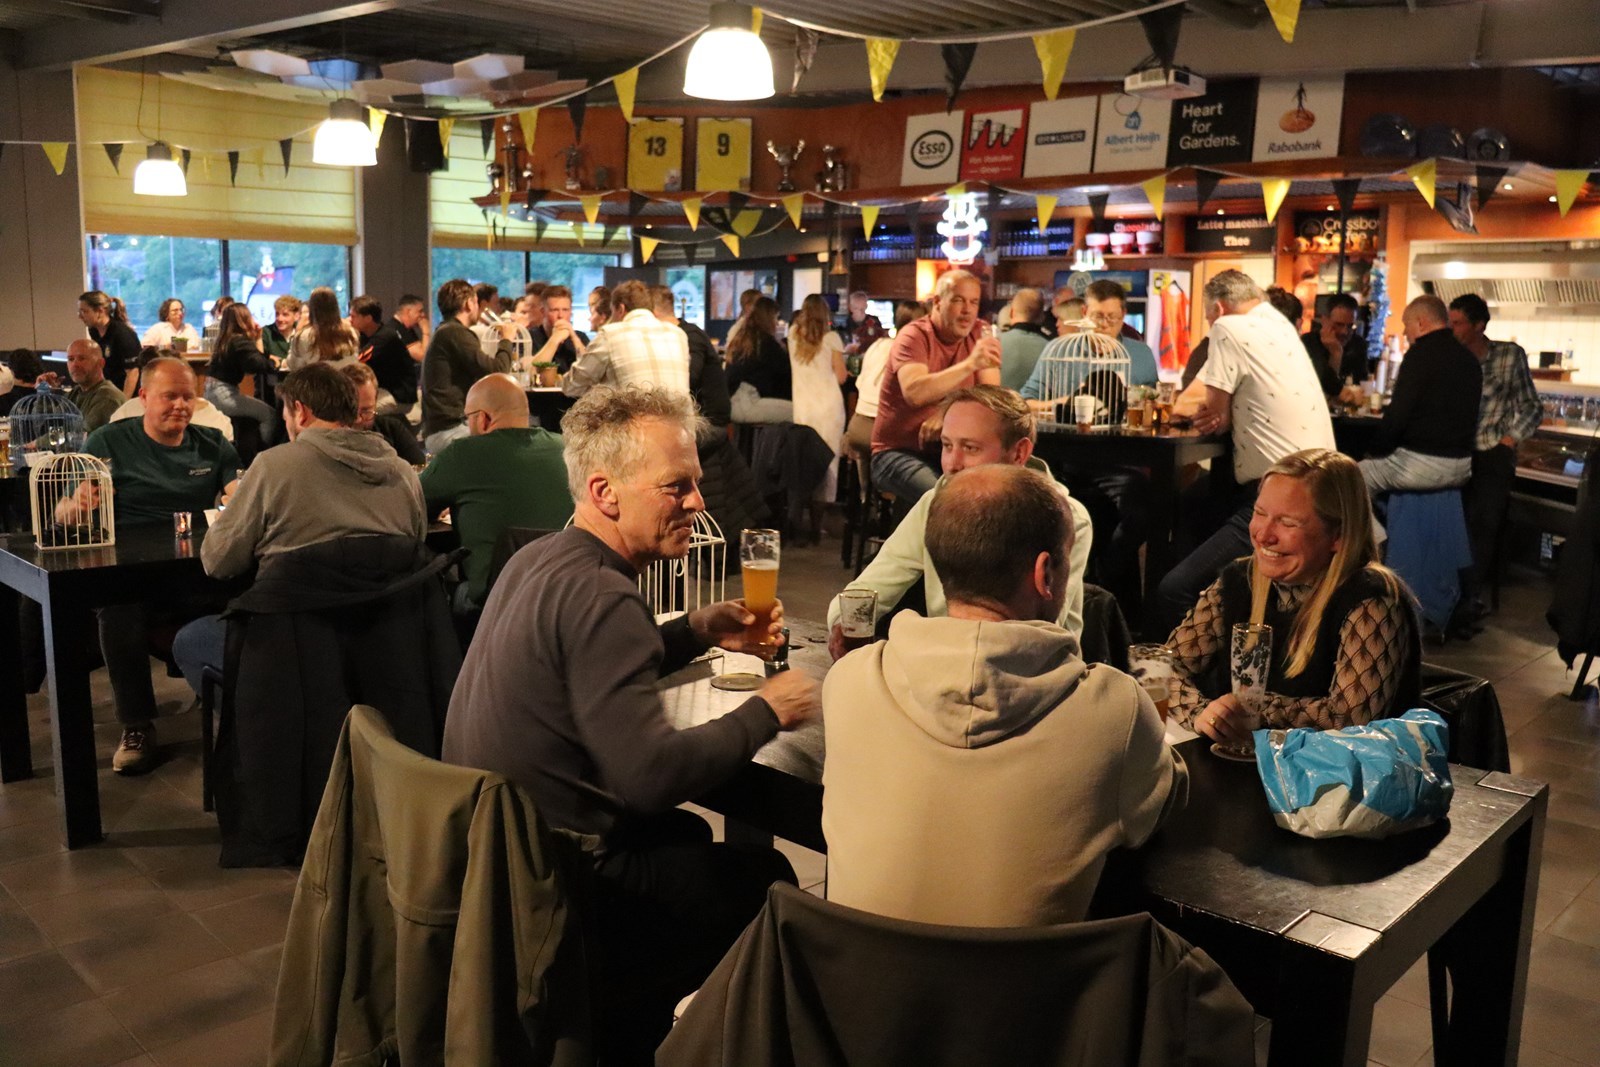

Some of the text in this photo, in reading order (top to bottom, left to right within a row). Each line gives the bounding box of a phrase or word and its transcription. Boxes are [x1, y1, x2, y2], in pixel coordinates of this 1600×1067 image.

[1182, 102, 1223, 118] Heart
[1191, 119, 1211, 134] for
[645, 136, 666, 157] 13
[717, 133, 730, 156] 9
[1105, 134, 1134, 145] Albert
[1267, 138, 1321, 154] Rabobank
[918, 141, 946, 155] Esso
[1197, 220, 1224, 230] Latte
[1223, 235, 1250, 247] Thee
